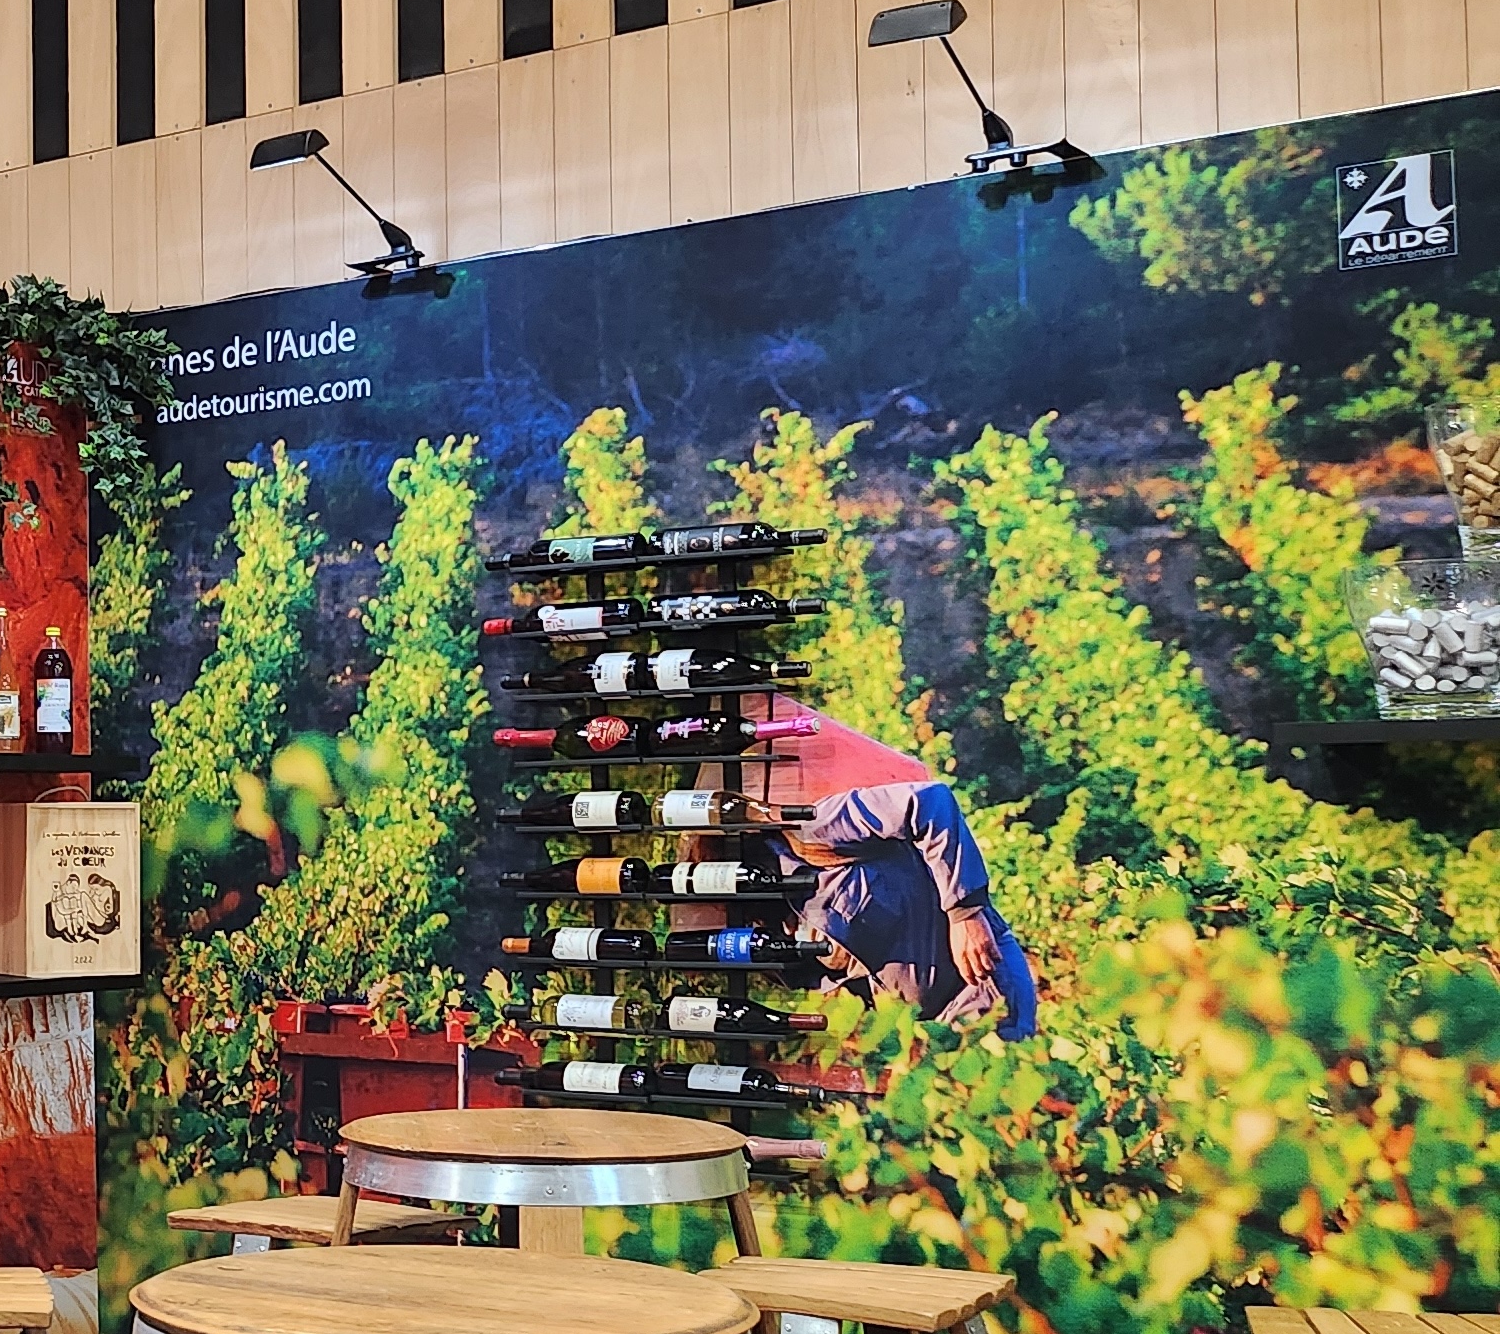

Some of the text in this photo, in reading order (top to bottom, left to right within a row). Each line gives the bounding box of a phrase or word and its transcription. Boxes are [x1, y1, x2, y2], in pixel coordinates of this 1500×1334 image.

[222, 335, 258, 369] de
[266, 320, 356, 363] l'Aude
[156, 376, 372, 424] audetourisme.com
[64, 844, 115, 857] VENDANGES
